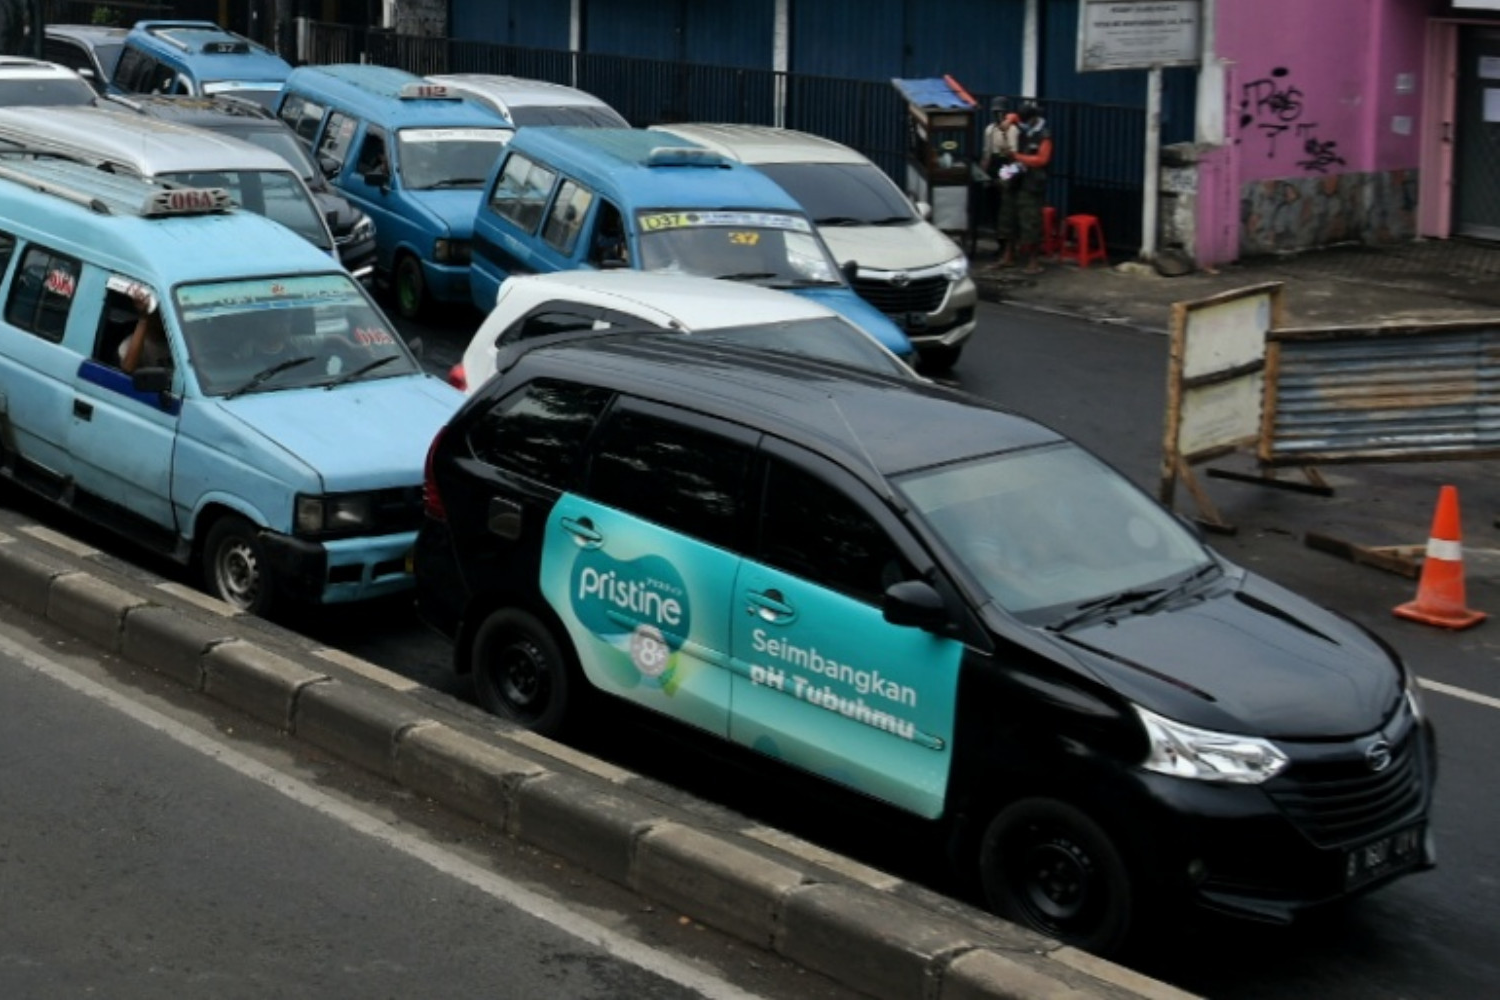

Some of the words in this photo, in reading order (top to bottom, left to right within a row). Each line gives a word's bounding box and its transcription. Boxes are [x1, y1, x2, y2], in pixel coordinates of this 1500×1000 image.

[170, 190, 214, 209] 06A
[644, 214, 681, 230] D37
[578, 567, 682, 626] pristine
[639, 637, 666, 667] 8+
[751, 628, 917, 707] Seimbangkan
[749, 664, 786, 691] pH
[791, 673, 915, 740] Tubuhmu
